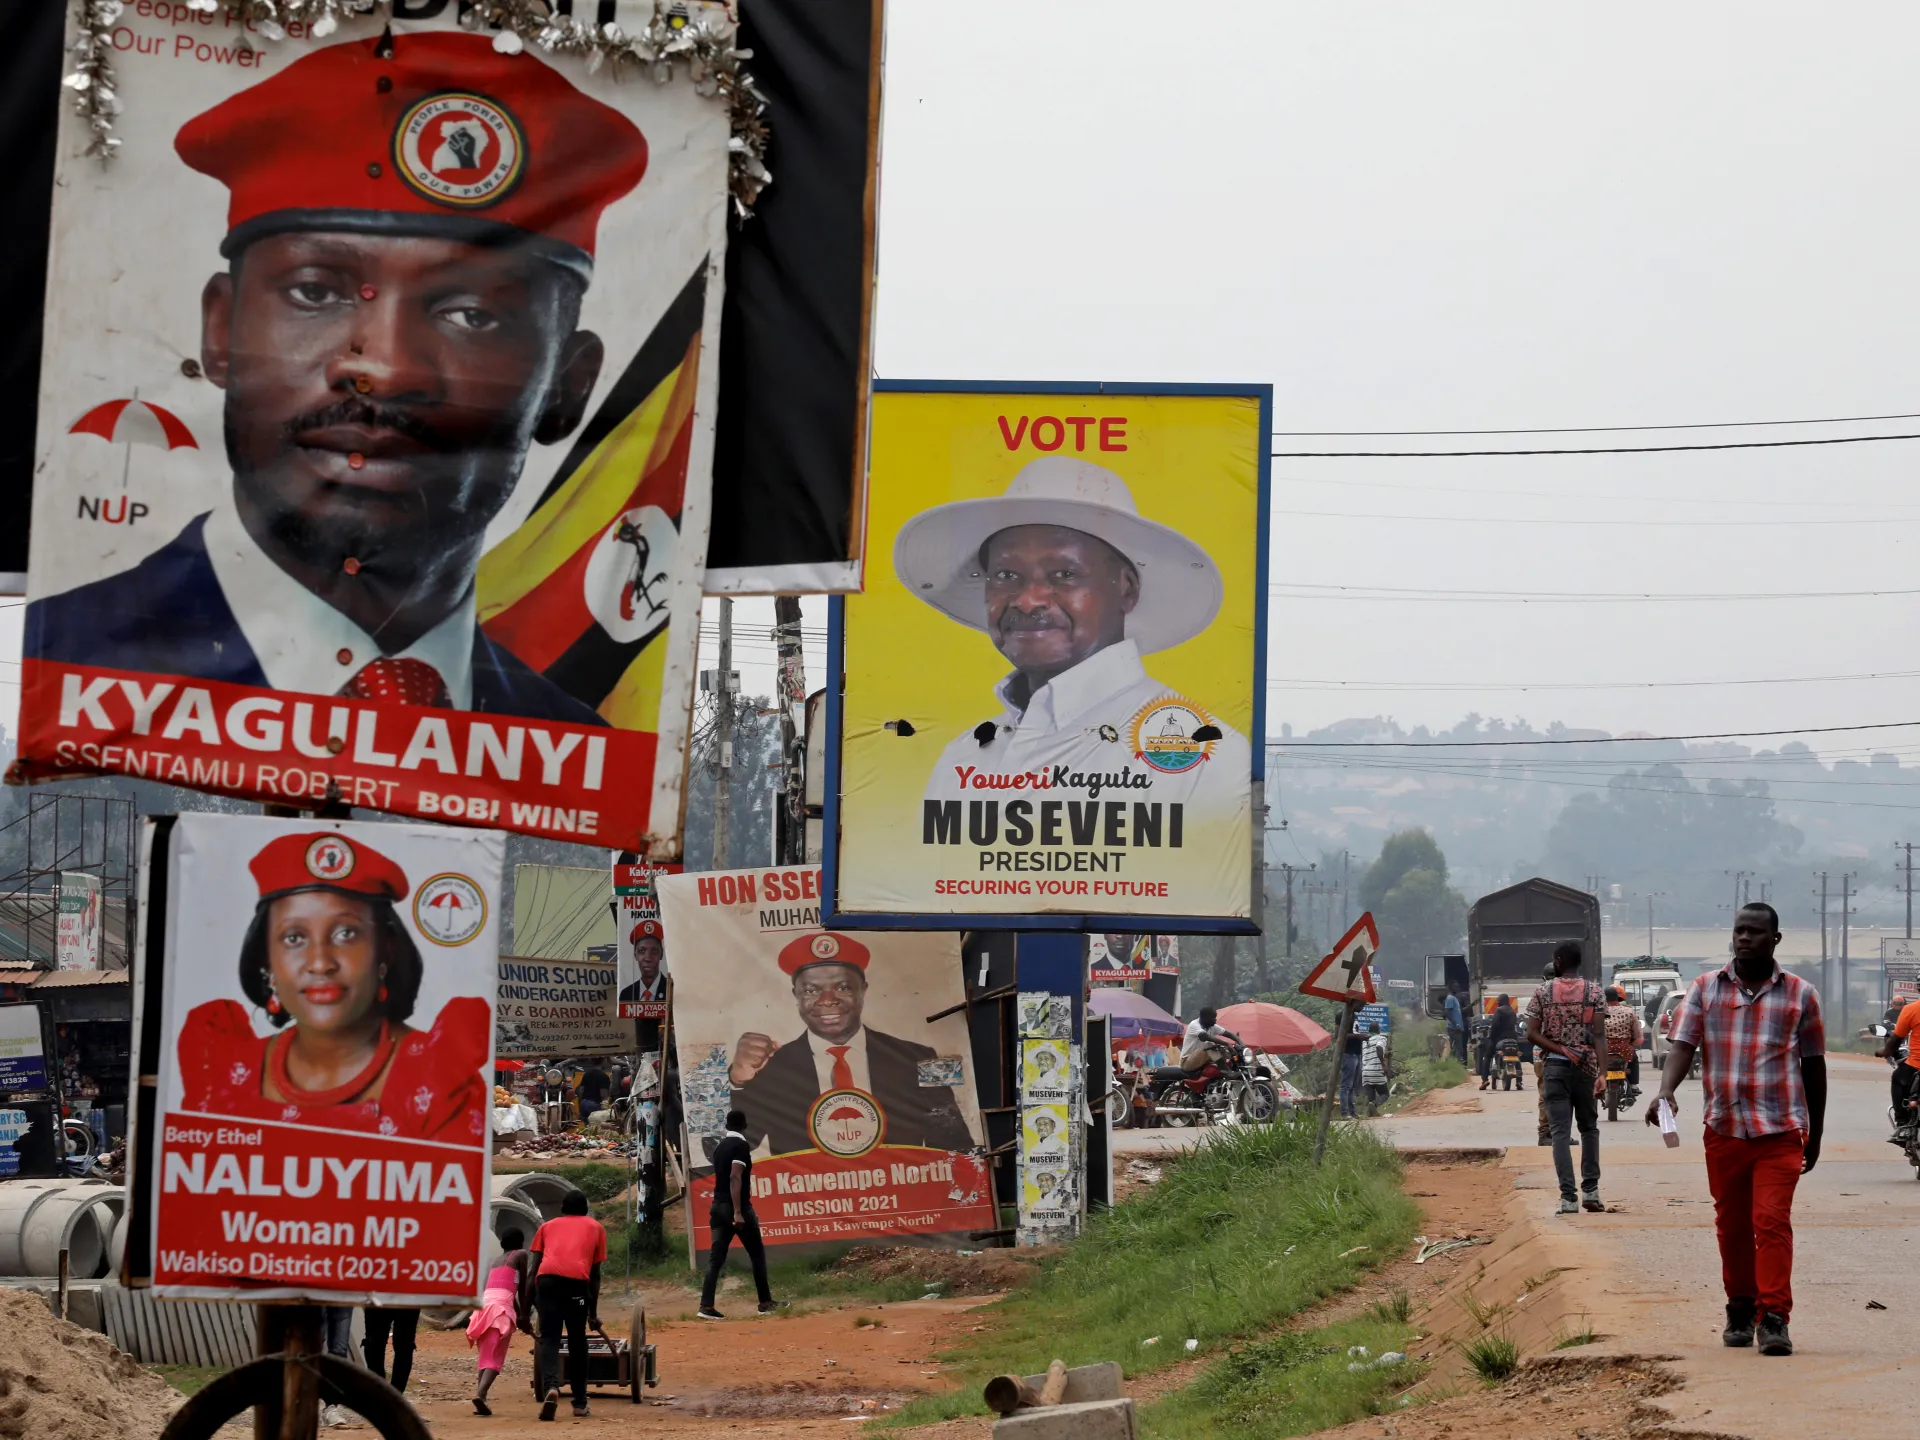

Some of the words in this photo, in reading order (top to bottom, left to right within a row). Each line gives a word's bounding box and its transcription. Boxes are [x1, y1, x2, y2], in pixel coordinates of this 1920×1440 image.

[121, 0, 213, 25] eople
[111, 27, 164, 55] Our
[174, 35, 266, 69] Power
[410, 102, 450, 134] PEOPLE
[463, 101, 505, 131] POWER
[420, 172, 452, 193] OUR
[464, 163, 509, 195] POWER
[997, 415, 1128, 452] VOTE
[77, 495, 149, 526] NUP
[59, 673, 607, 791] KYAGULANYI
[55, 740, 245, 789] SSENTAMU
[256, 765, 400, 809] ROBERT
[418, 791, 500, 822] BOBI
[511, 802, 598, 835] WINE
[922, 799, 1184, 848] MUSEVENI
[979, 851, 1127, 873] PRESIDENT
[698, 874, 757, 906] HON
[934, 879, 1031, 895] SECURING
[1035, 880, 1088, 895] YOUR
[1093, 881, 1169, 897] FUTURE
[623, 896, 657, 910] MUW
[552, 966, 618, 986] SCHOOL
[1095, 969, 1146, 977] KYAGULANYI
[497, 984, 608, 1003] KINDERGARTEN
[515, 1005, 524, 1017] &
[529, 1005, 605, 1019] BOARDING
[627, 1004, 644, 1017] MP
[515, 1045, 557, 1053] TREASURE
[3, 1076, 28, 1084] U3826
[1029, 1090, 1063, 1098] MUSEVENI
[13, 1112, 26, 1124] SC
[816, 1100, 834, 1127] NATIONAL
[832, 1096, 852, 1104] UNITY
[852, 1096, 877, 1123] PLATFORM
[164, 1126, 213, 1148] Betty
[216, 1127, 262, 1146] Ethel
[837, 1130, 862, 1142] NUP
[1029, 1156, 1064, 1164] MUSEVENI
[163, 1151, 474, 1205] NALUYIMA
[776, 1168, 886, 1194] Kawempe
[891, 1160, 953, 1185] North
[783, 1197, 853, 1217] MISSION
[859, 1195, 898, 1212] 2021
[1030, 1211, 1065, 1220] MUSEVENI
[221, 1210, 355, 1247] Woman
[363, 1216, 420, 1249] MP
[760, 1223, 802, 1237] Esuubi
[805, 1221, 830, 1236] Lya
[833, 1218, 894, 1233] Kawempe
[160, 1249, 244, 1275] Wakiso
[249, 1251, 333, 1278] District
[337, 1255, 475, 1287] (2021-2026)
